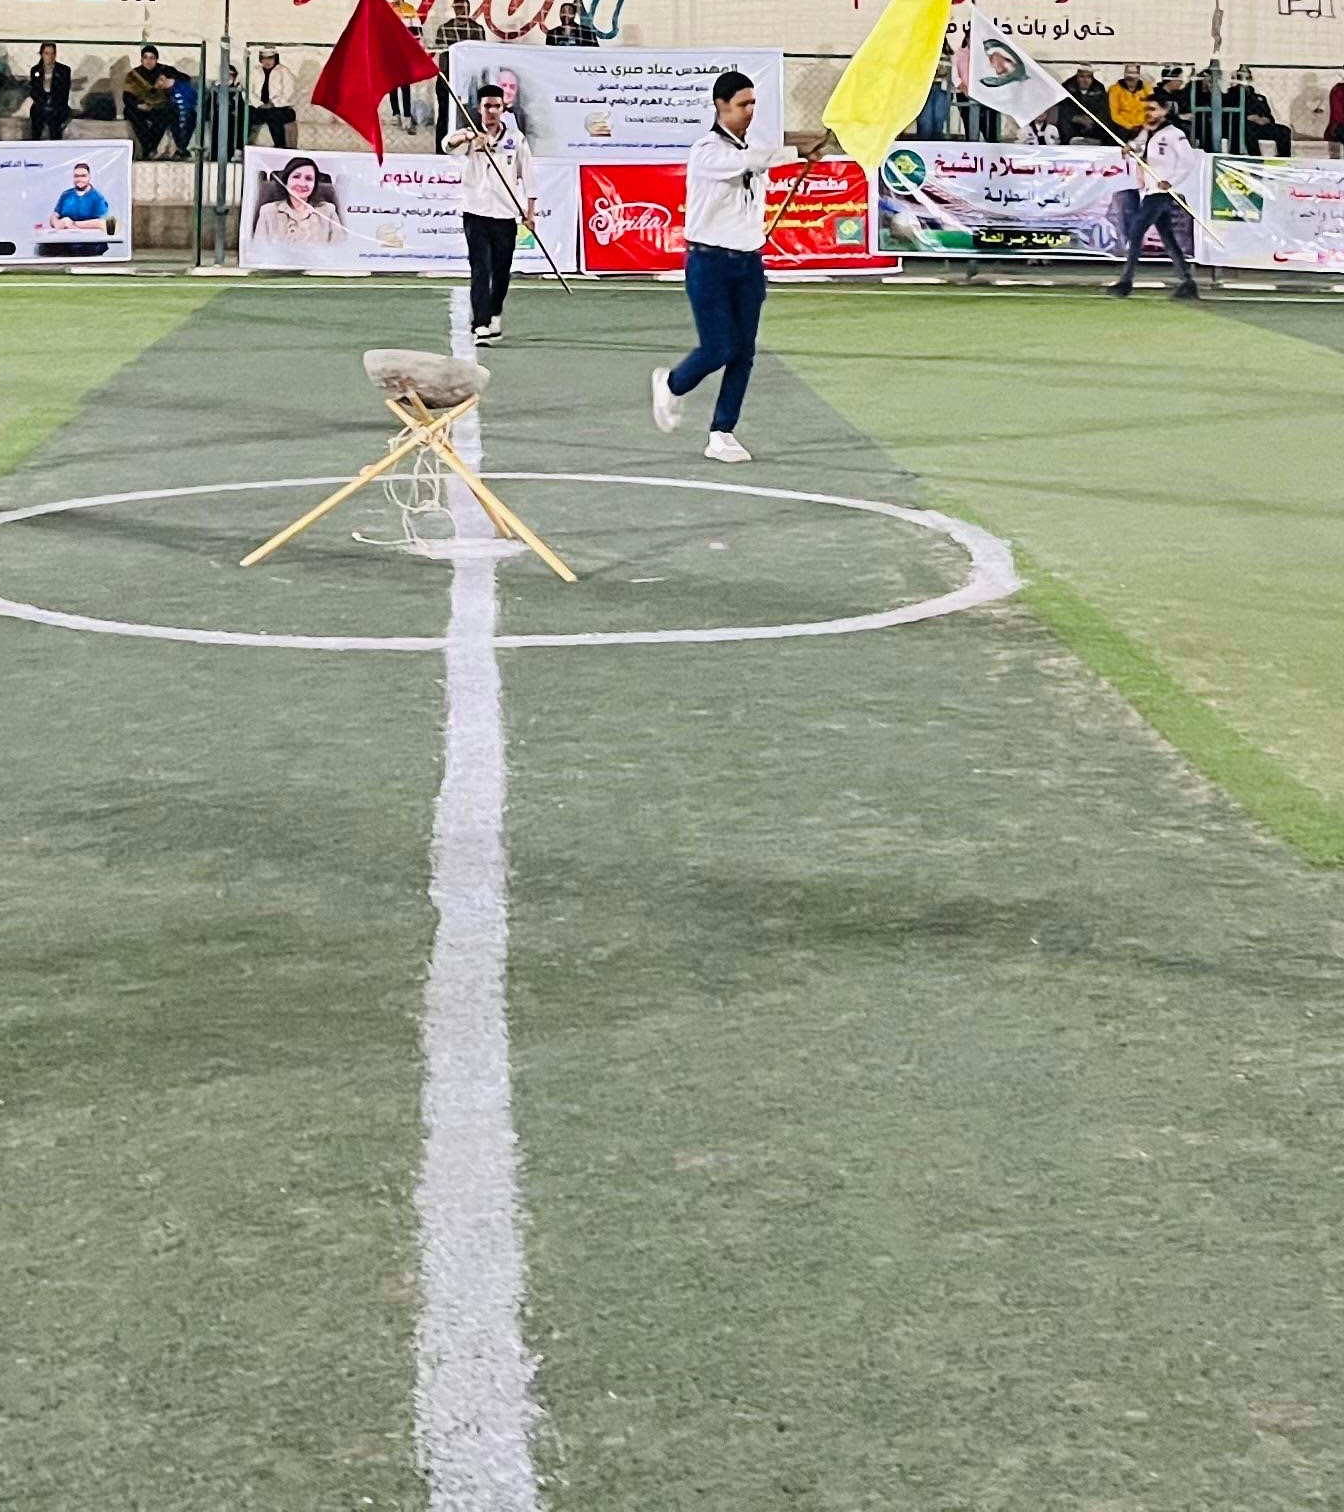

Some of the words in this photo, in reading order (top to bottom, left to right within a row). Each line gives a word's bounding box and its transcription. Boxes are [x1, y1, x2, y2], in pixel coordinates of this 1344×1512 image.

[934, 152, 984, 178] الشيخ
[989, 156, 1042, 179] السلام
[380, 170, 424, 188] باخوم
[984, 186, 1035, 207] البطولة
